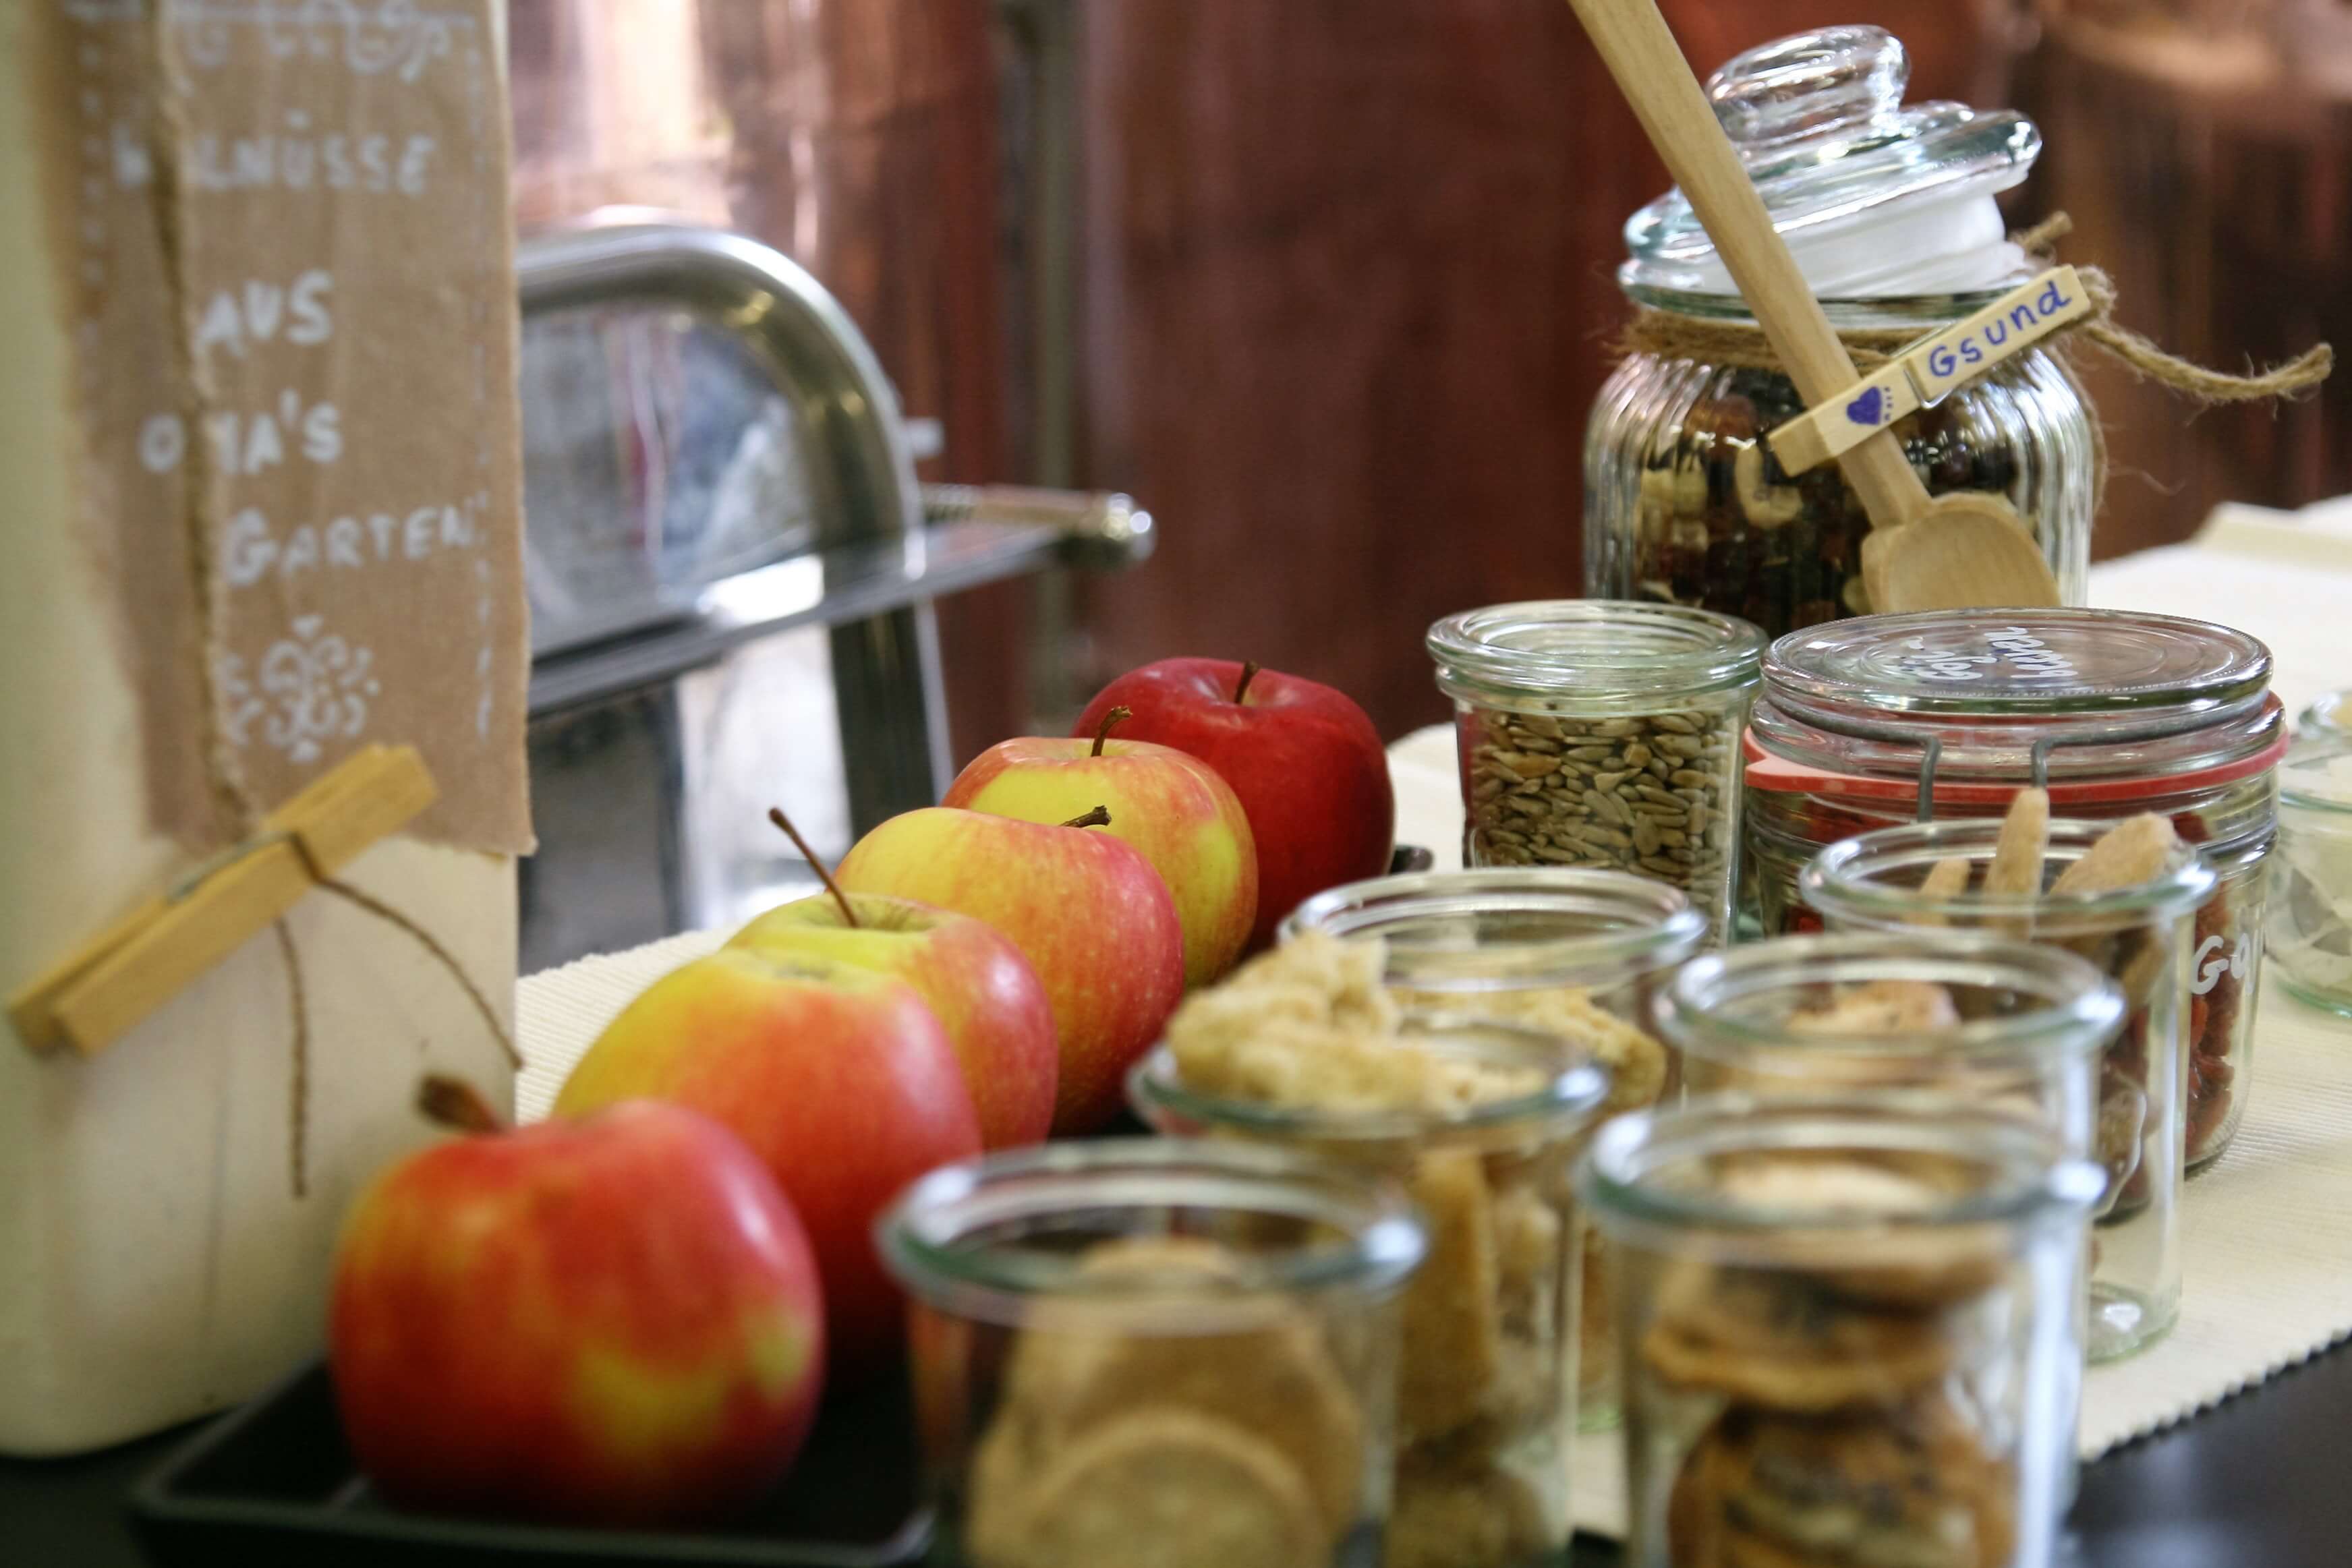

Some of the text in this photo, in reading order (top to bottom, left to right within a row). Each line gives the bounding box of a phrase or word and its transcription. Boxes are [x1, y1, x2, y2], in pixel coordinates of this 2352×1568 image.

[110, 109, 435, 196] WLNÜSSE
[193, 267, 335, 357] AUS
[1929, 280, 2072, 377] Gsund
